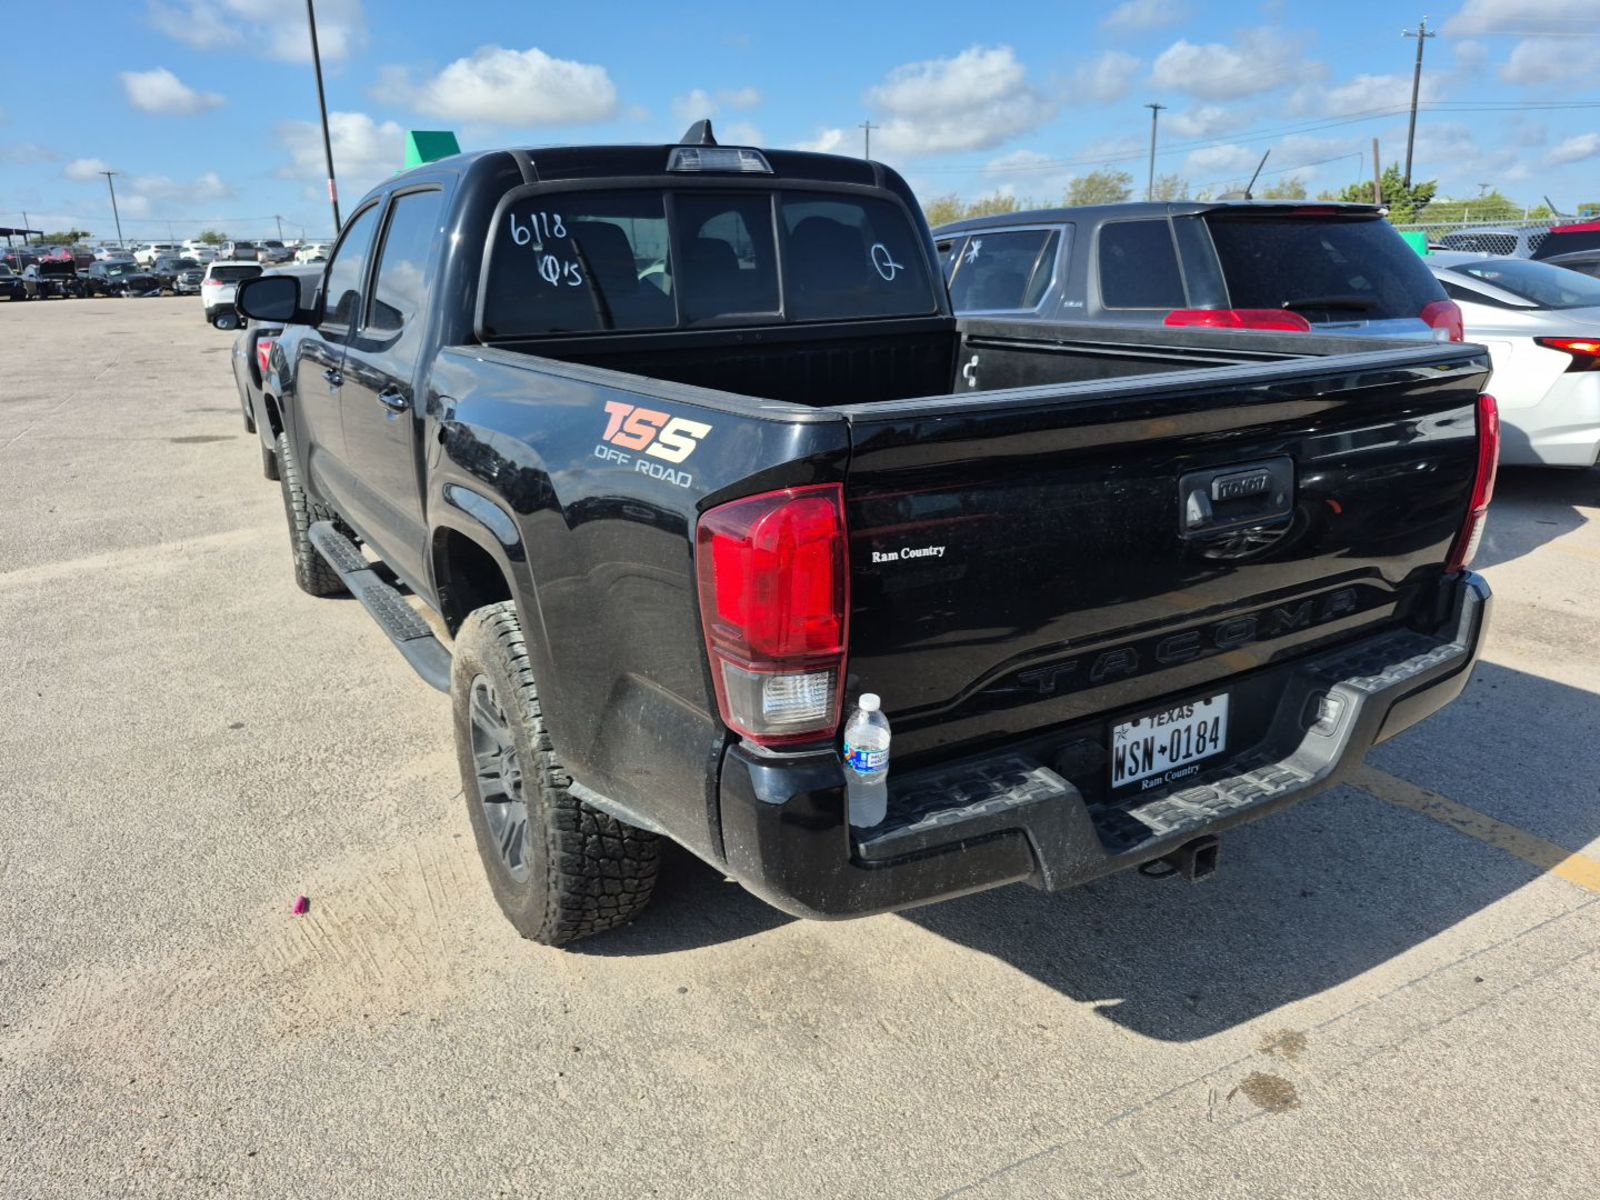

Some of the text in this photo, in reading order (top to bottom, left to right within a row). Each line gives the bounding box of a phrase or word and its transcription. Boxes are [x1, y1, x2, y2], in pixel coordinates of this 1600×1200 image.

[602, 400, 713, 464] TSS
[594, 444, 693, 488] OFF ROAD
[872, 545, 946, 563] Ram Country
[1016, 587, 1358, 694] TACOMA
[1148, 704, 1195, 729] TEXAS
[1141, 764, 1201, 790] Ram Country
